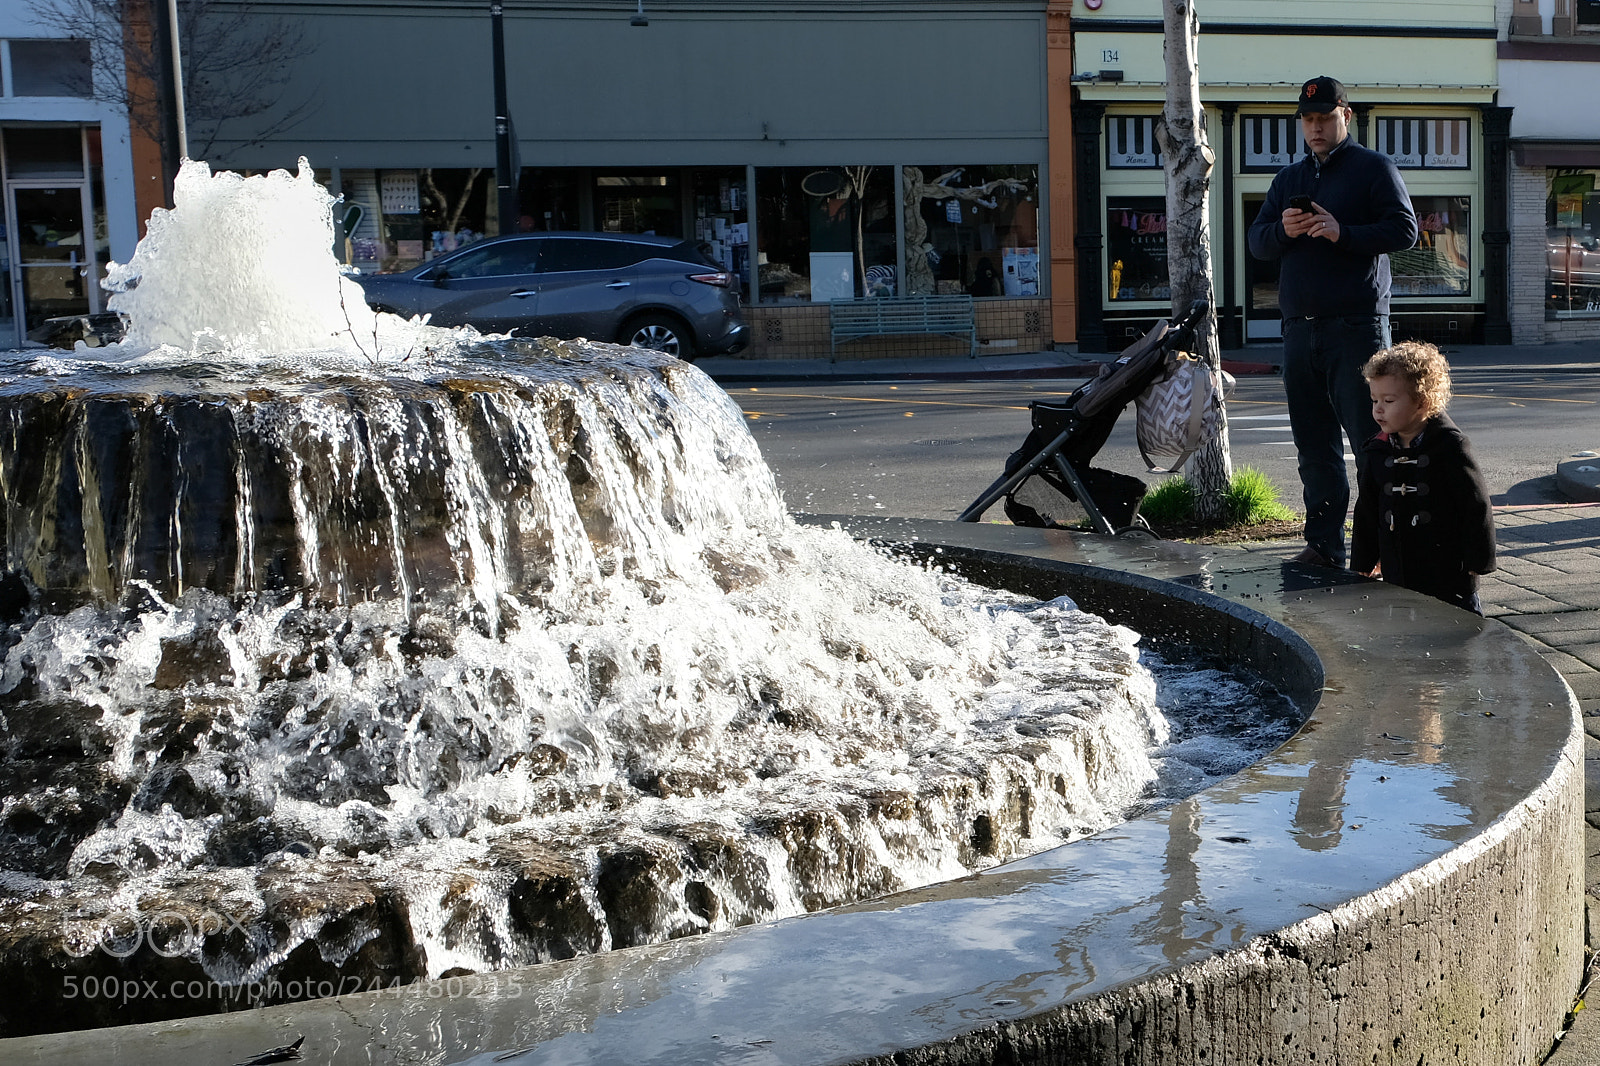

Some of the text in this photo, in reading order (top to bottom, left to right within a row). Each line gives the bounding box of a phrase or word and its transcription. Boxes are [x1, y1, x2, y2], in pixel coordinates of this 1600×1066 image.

[1102, 50, 1119, 63] 134
[1126, 155, 1148, 164] Home
[1393, 156, 1416, 165] Sodas
[1430, 156, 1458, 165] Shakes
